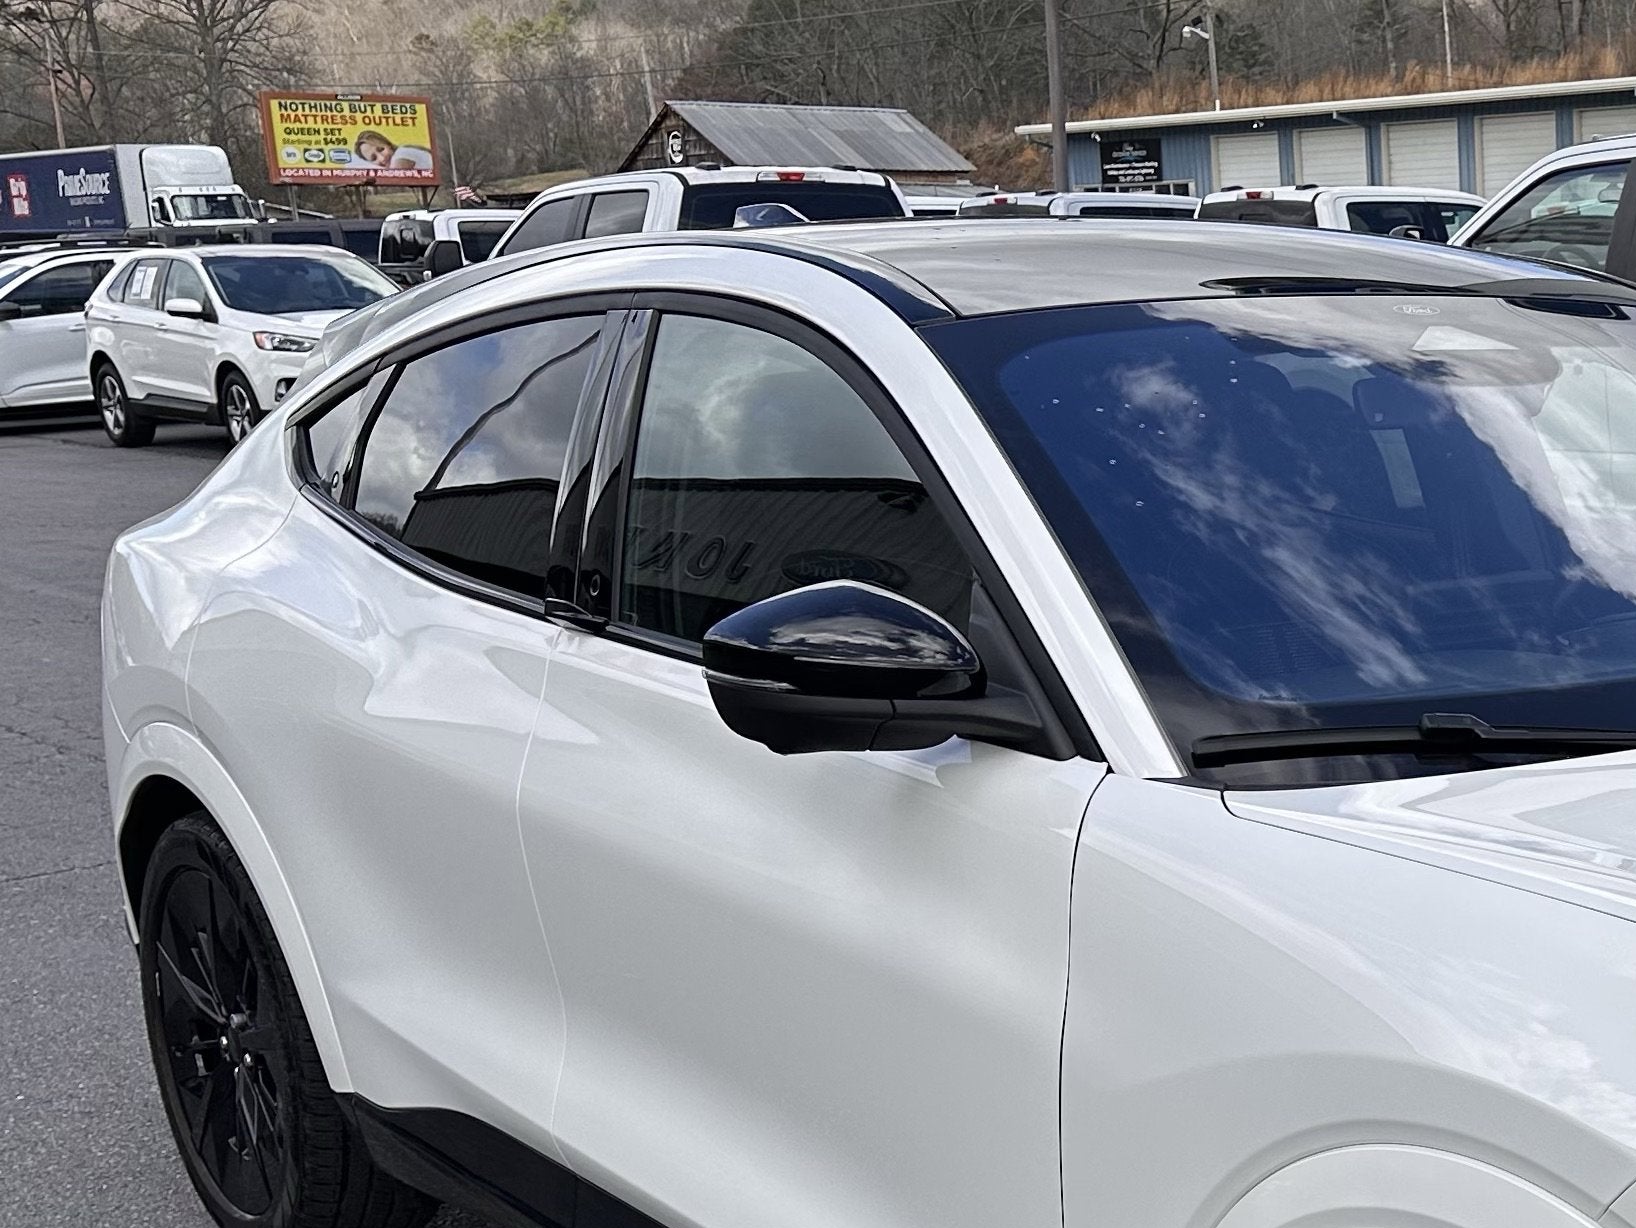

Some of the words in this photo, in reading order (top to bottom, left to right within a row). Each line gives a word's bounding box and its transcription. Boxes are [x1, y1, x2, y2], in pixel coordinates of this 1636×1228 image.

[278, 101, 344, 113] NOTHING
[349, 103, 376, 115] BUT
[381, 104, 417, 115] BEDS
[279, 113, 358, 126] MATTRESS
[362, 115, 417, 127] OUTLET
[284, 126, 321, 136] QUEEN
[323, 127, 343, 136] SET
[323, 137, 348, 146] $499
[280, 169, 321, 177] LOCATED
[322, 169, 332, 177] IN
[377, 170, 420, 178] ANDREWS,
